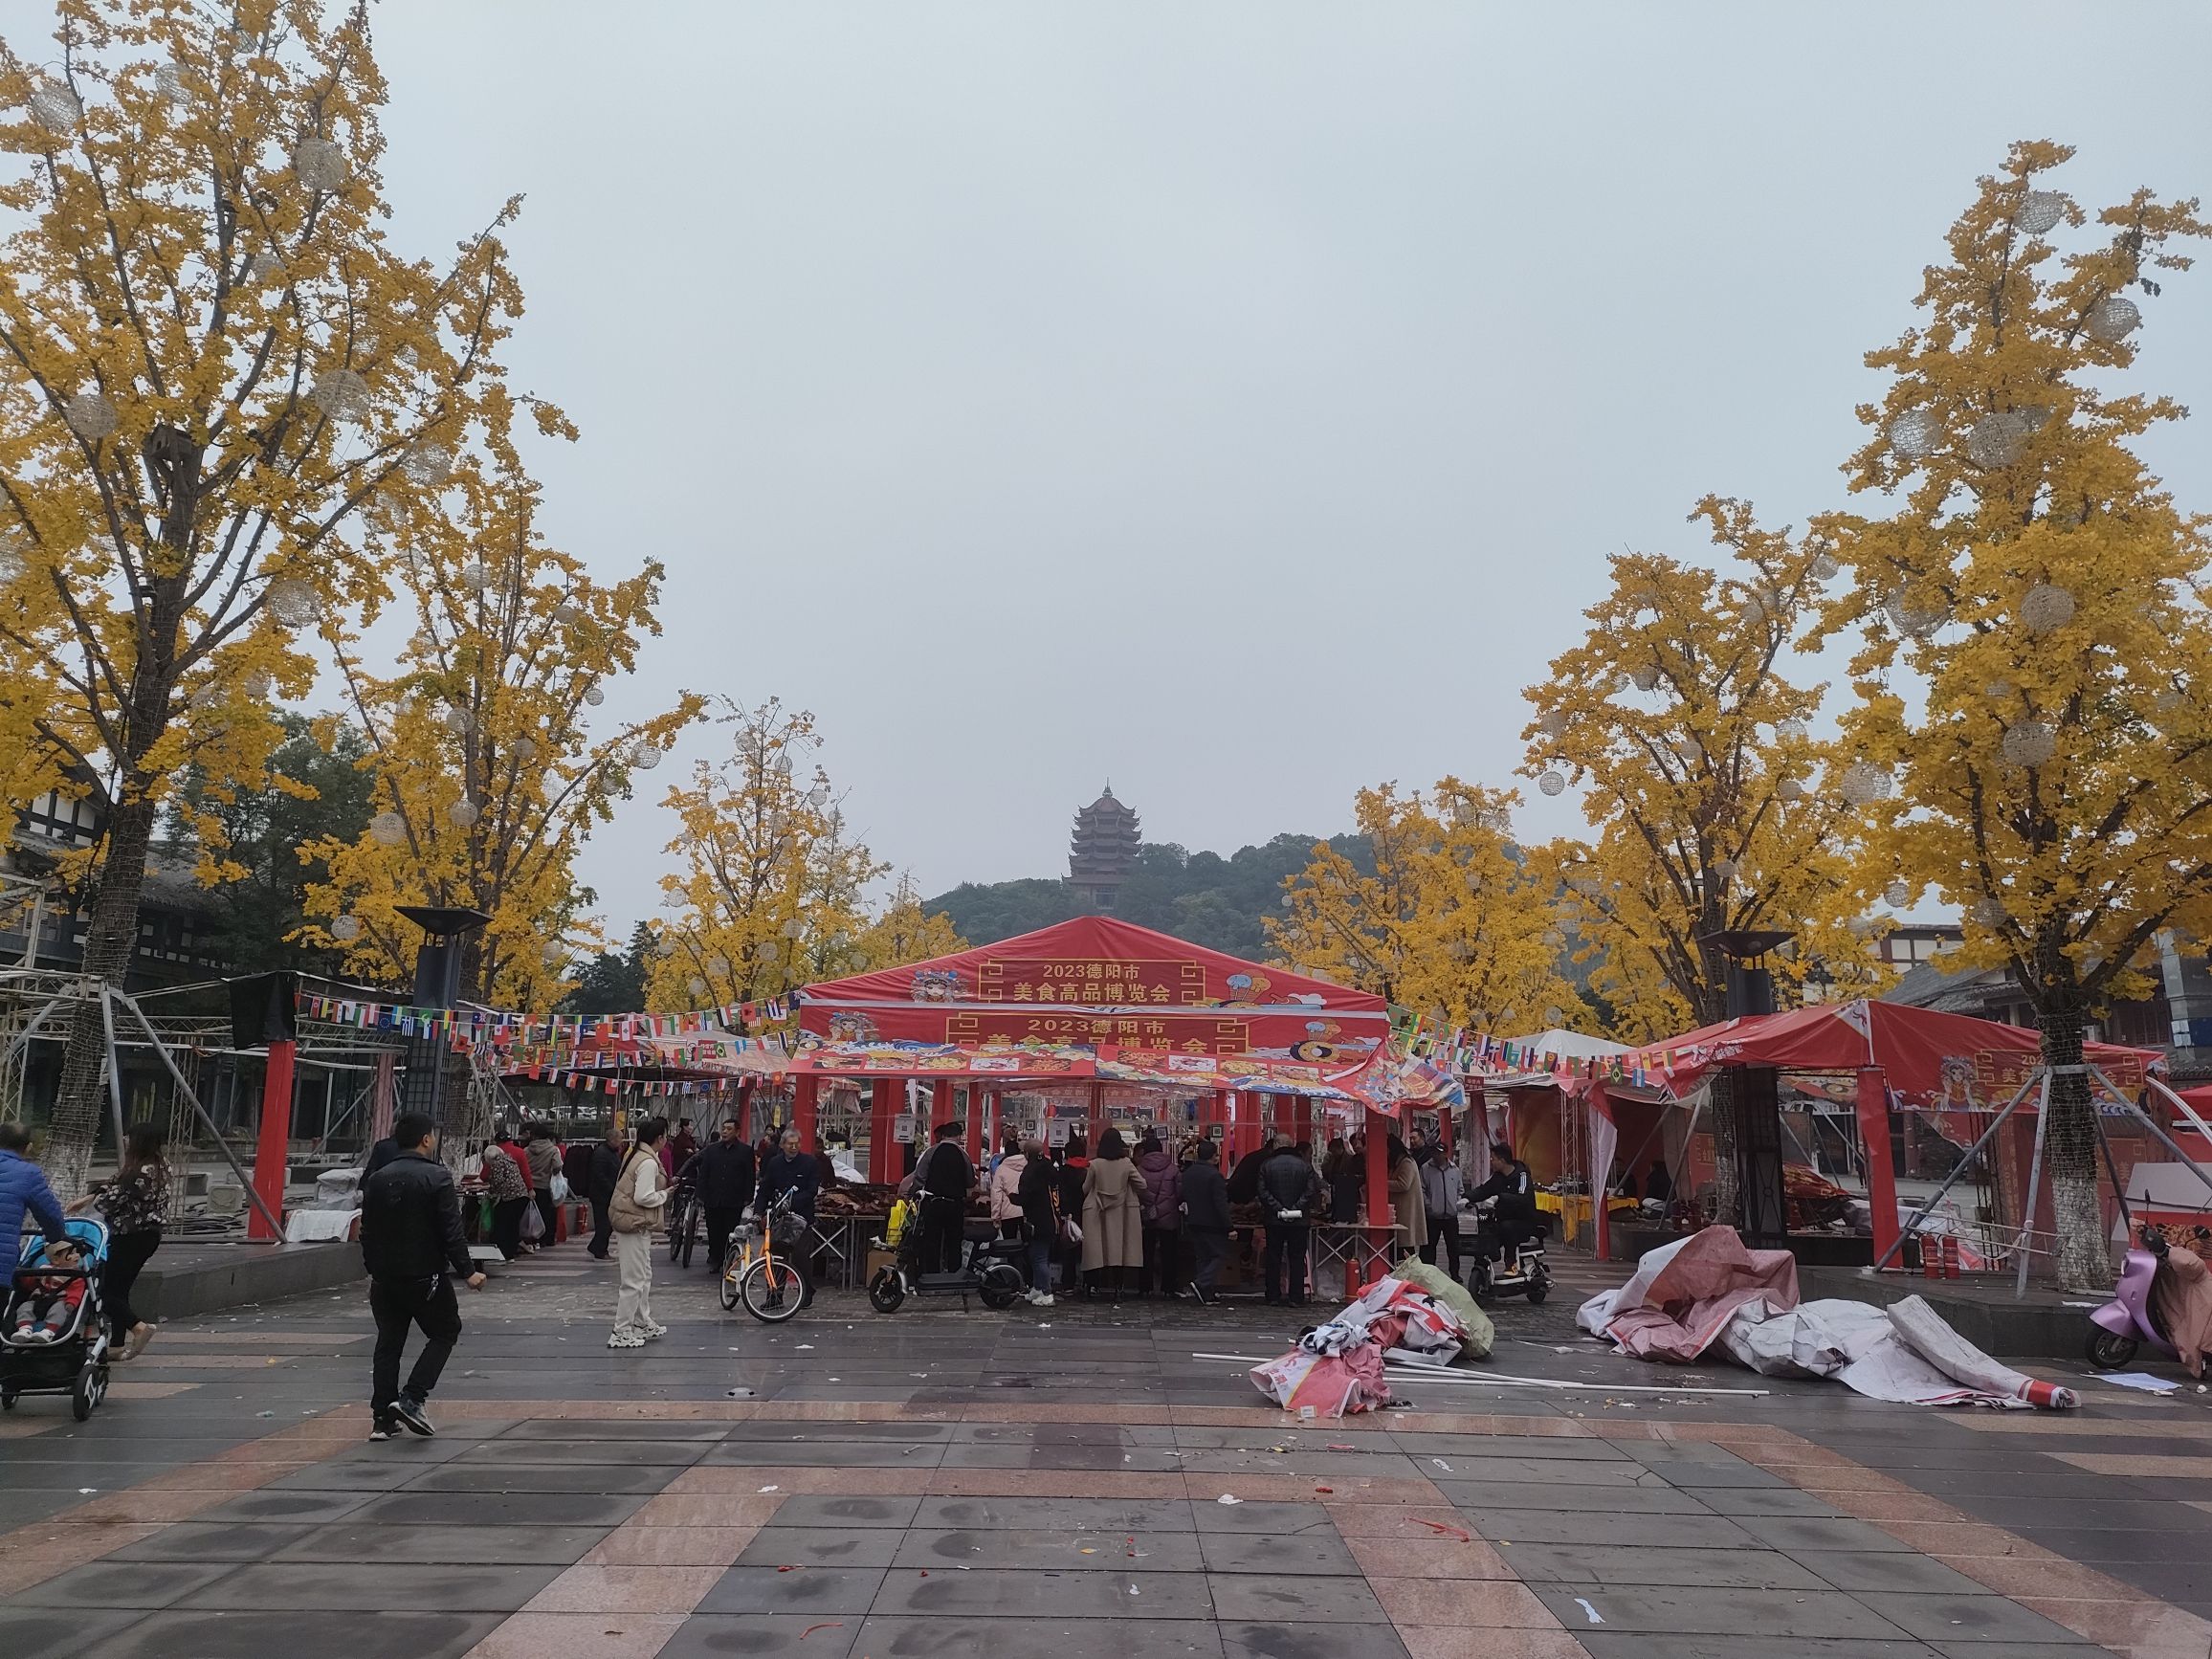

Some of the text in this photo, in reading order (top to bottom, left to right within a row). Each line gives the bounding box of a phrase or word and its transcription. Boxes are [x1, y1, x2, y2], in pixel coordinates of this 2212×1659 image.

[1043, 963, 1140, 980] 2023德阳市
[1013, 982, 1171, 1003] 美食高品博览会
[1028, 1019, 1165, 1034] 2023德阳市
